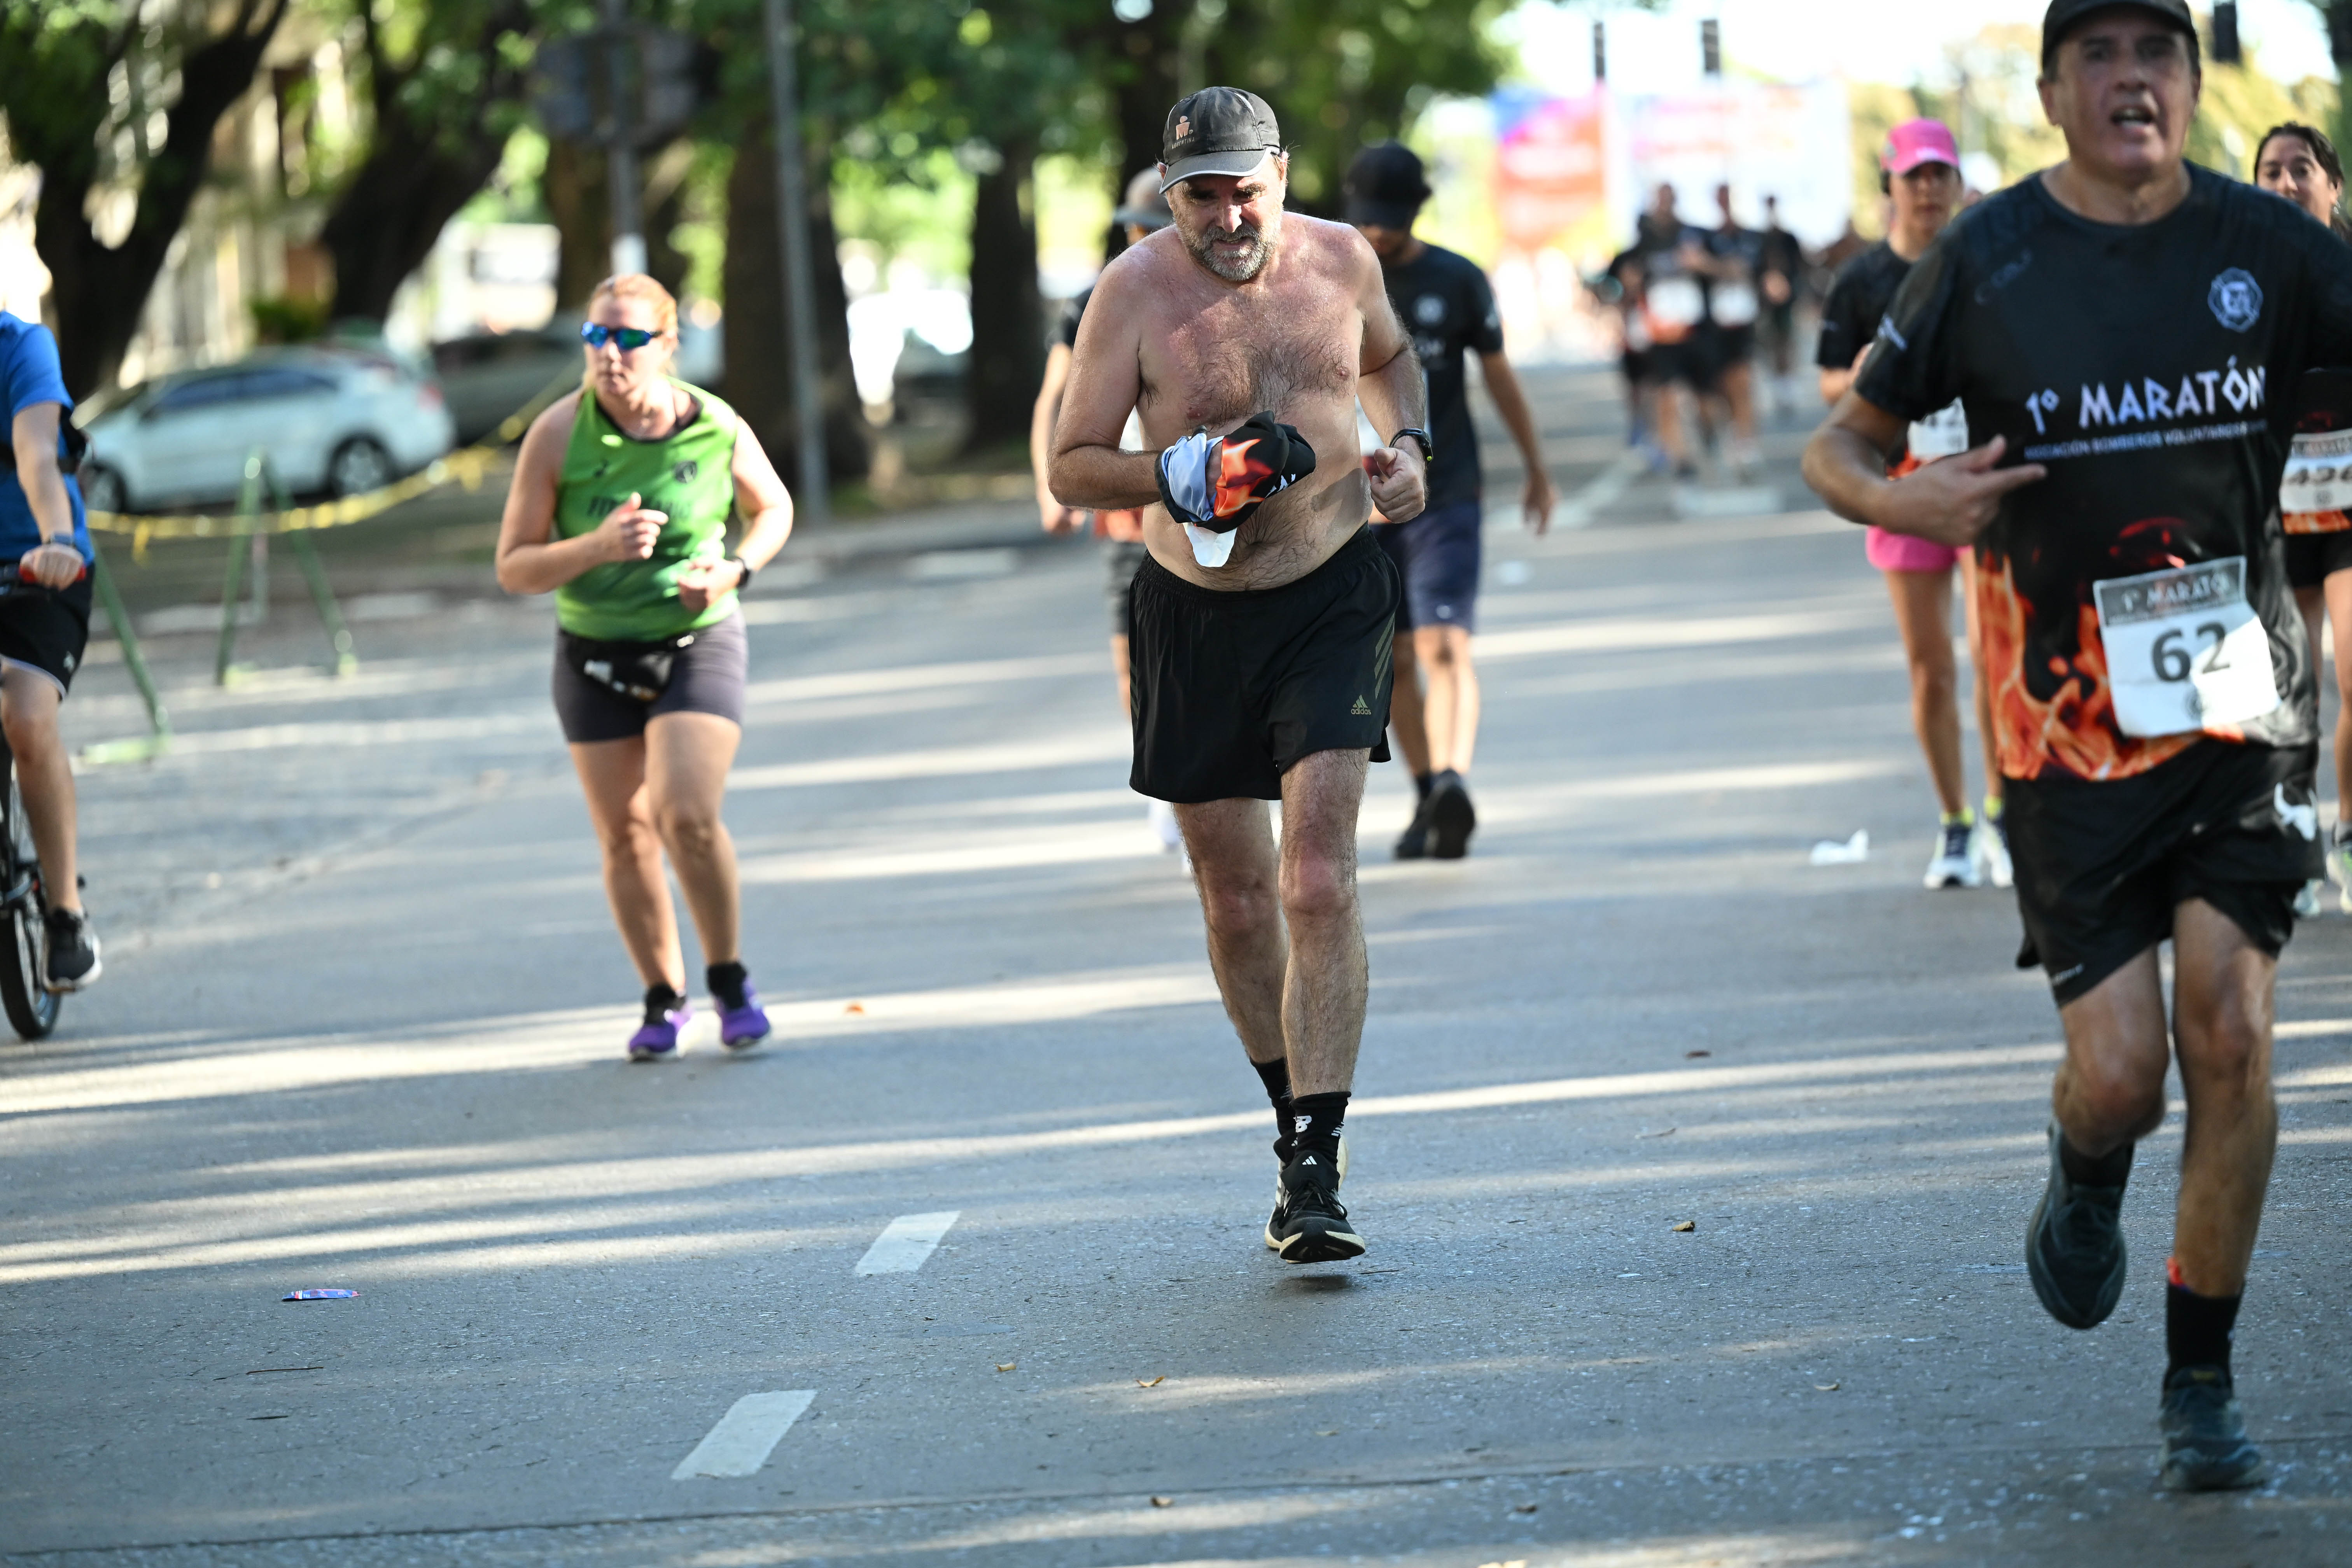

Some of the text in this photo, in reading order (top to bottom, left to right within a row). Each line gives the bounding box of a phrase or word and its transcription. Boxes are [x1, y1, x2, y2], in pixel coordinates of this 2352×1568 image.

[1172, 137, 1195, 150] ARGENTINA
[2078, 354, 2266, 429] MARATÓN
[2151, 621, 2231, 683] 62
[1350, 707, 1372, 715] adidas
